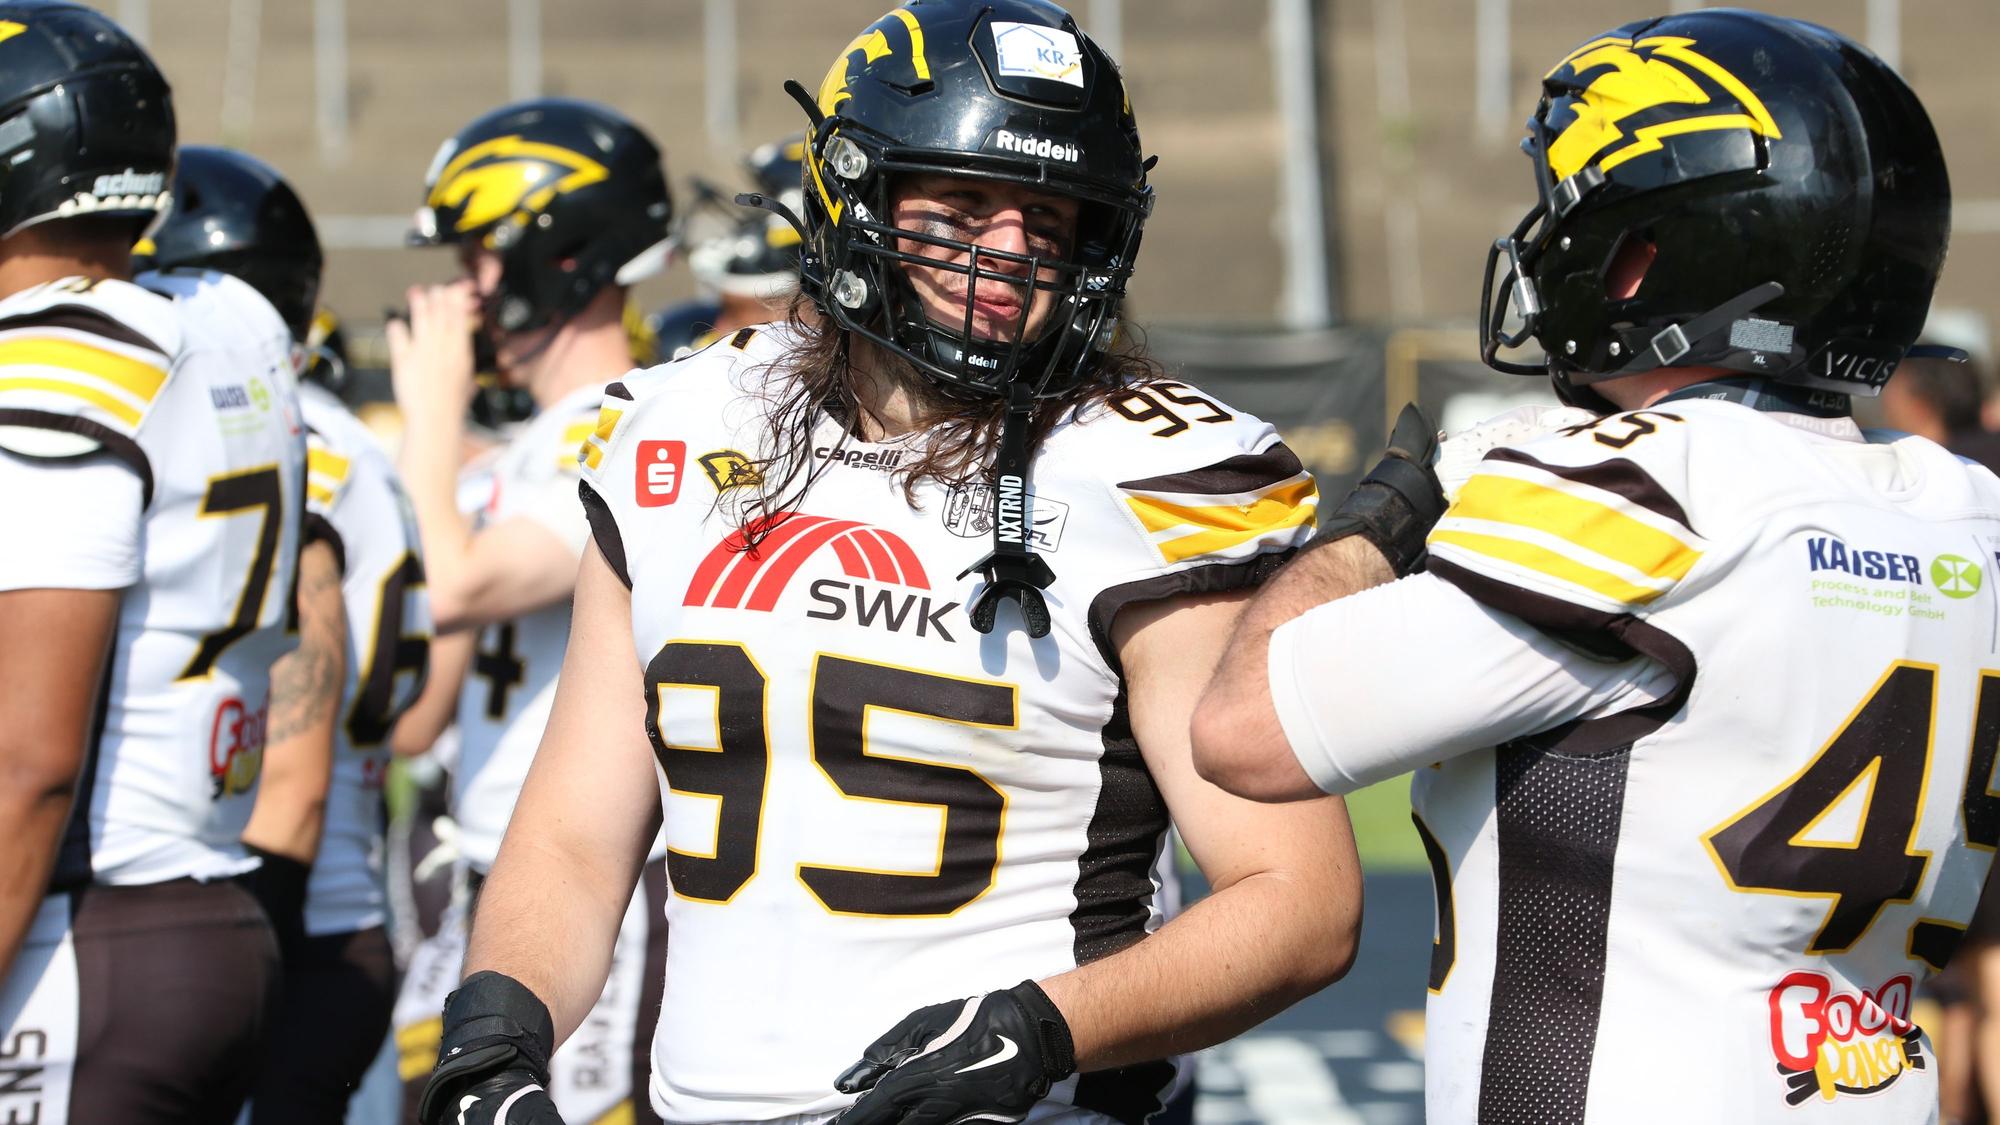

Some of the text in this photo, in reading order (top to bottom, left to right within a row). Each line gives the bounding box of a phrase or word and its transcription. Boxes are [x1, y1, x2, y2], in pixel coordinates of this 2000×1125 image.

[1037, 48, 1065, 66] KR
[996, 130, 1079, 162] Riddell
[955, 350, 998, 369] Rddell
[1753, 355, 1766, 364] XL
[1826, 351, 1896, 382] VICIS
[1104, 383, 1233, 438] 95
[815, 447, 903, 466] capelli
[998, 475, 1022, 543] NXTRND
[1808, 537, 1922, 585] KAISER
[1812, 596, 1945, 620] Technology GmbH
[1873, 588, 1906, 600] and
[807, 579, 961, 643] SWK
[644, 640, 1019, 918] 95
[1769, 973, 1914, 1072] Food
